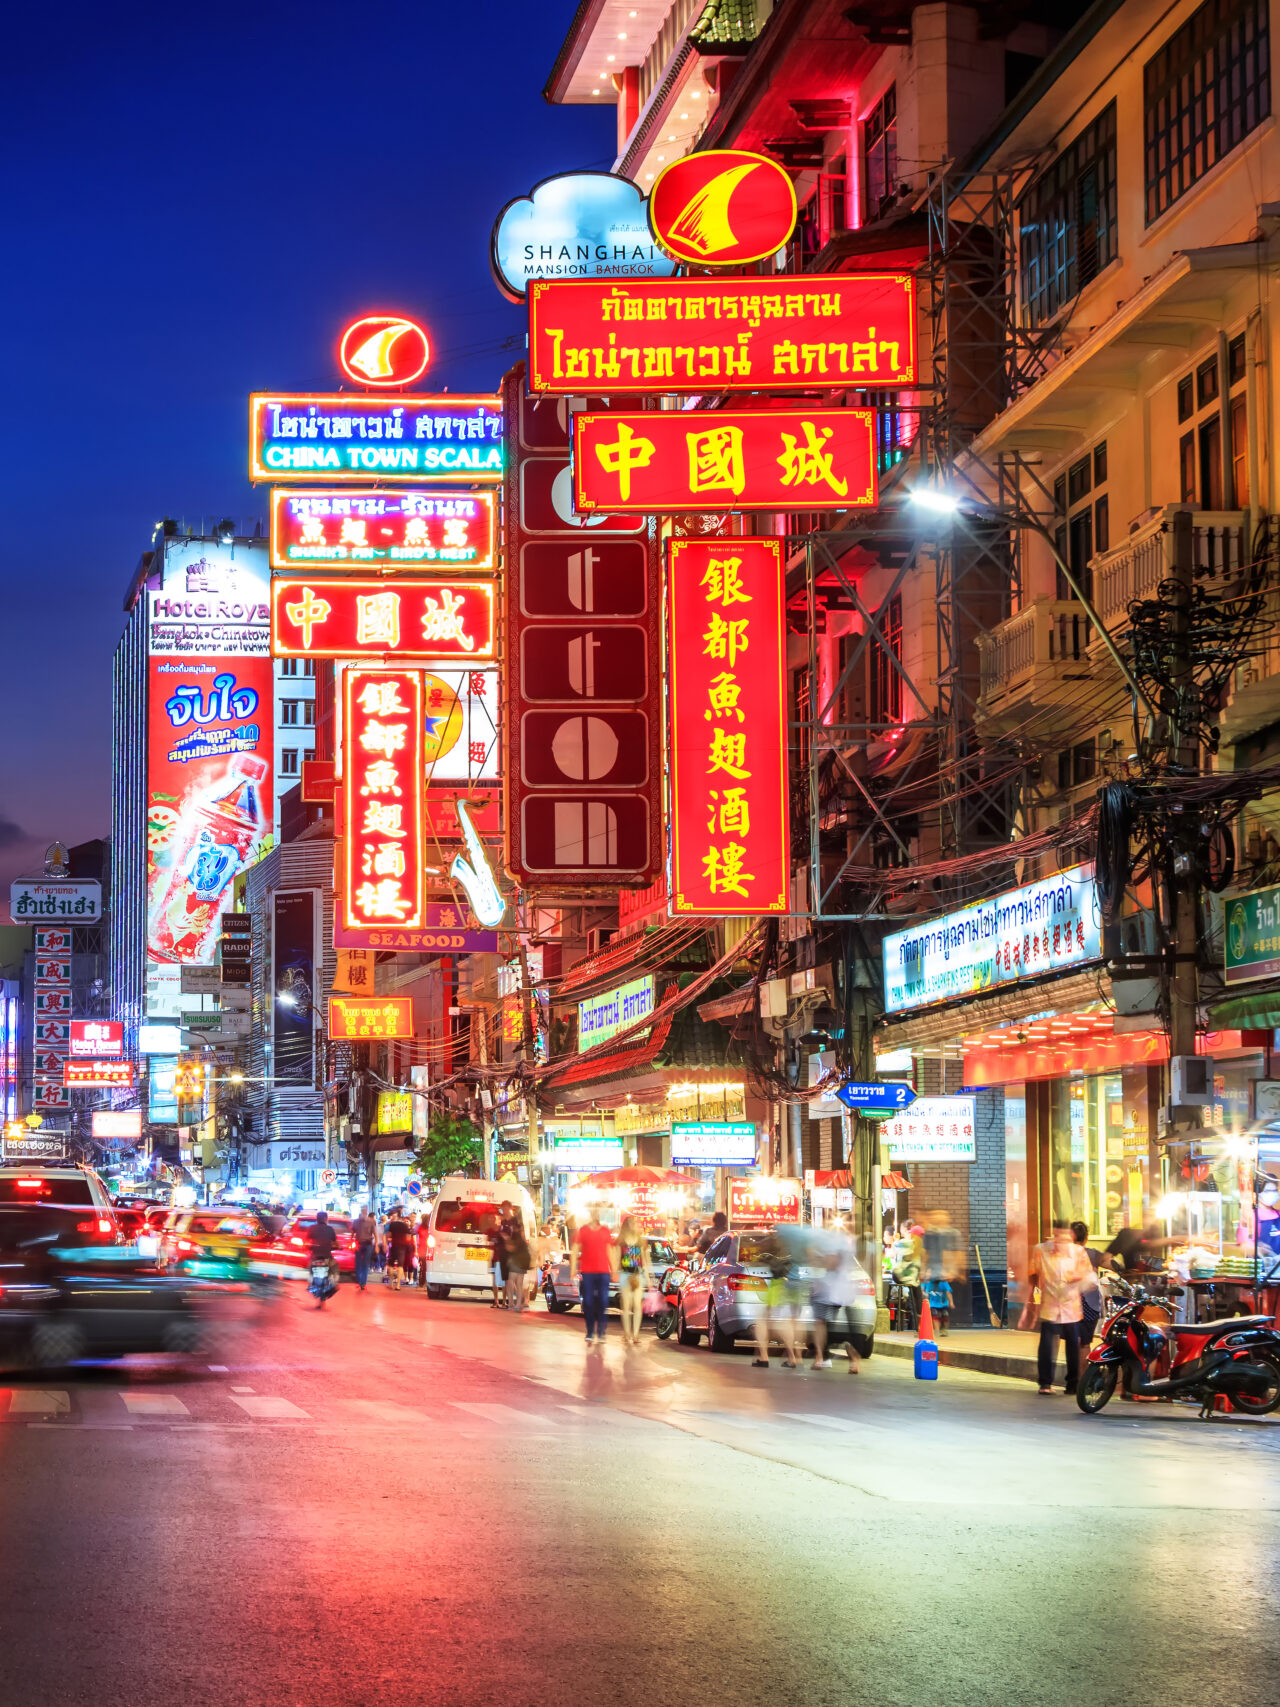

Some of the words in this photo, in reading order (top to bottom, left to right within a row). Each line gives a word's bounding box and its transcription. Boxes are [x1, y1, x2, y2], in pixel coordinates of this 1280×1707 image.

[524, 245, 654, 260] SHANGHAI
[524, 265, 587, 274] MANSION
[596, 265, 654, 274] BANGKOK
[545, 327, 752, 379] ไชน่าทาวน์
[773, 326, 901, 374] สกาล่า
[267, 403, 404, 438] ไชน่าทาวน์
[266, 447, 341, 468] CHINA
[347, 448, 419, 468] TOWN
[424, 448, 502, 468] SCALA
[595, 420, 848, 503] 中國城
[440, 547, 476, 560] NEST
[153, 598, 212, 618] Hotel
[285, 586, 475, 651] 中國城
[166, 674, 258, 727] จับใจ
[698, 556, 756, 899] 銀都魚翅酒樓
[355, 680, 413, 920] 銀都魚翅酒樓
[17, 891, 96, 915] ฮั่วเซ่งเฮง
[223, 920, 250, 928] CITIZEN
[368, 933, 466, 949] SEAFOOD
[42, 933, 64, 1103] 和成興大金行
[848, 1086, 886, 1096] เยาวราช
[896, 1088, 906, 1102] 2
